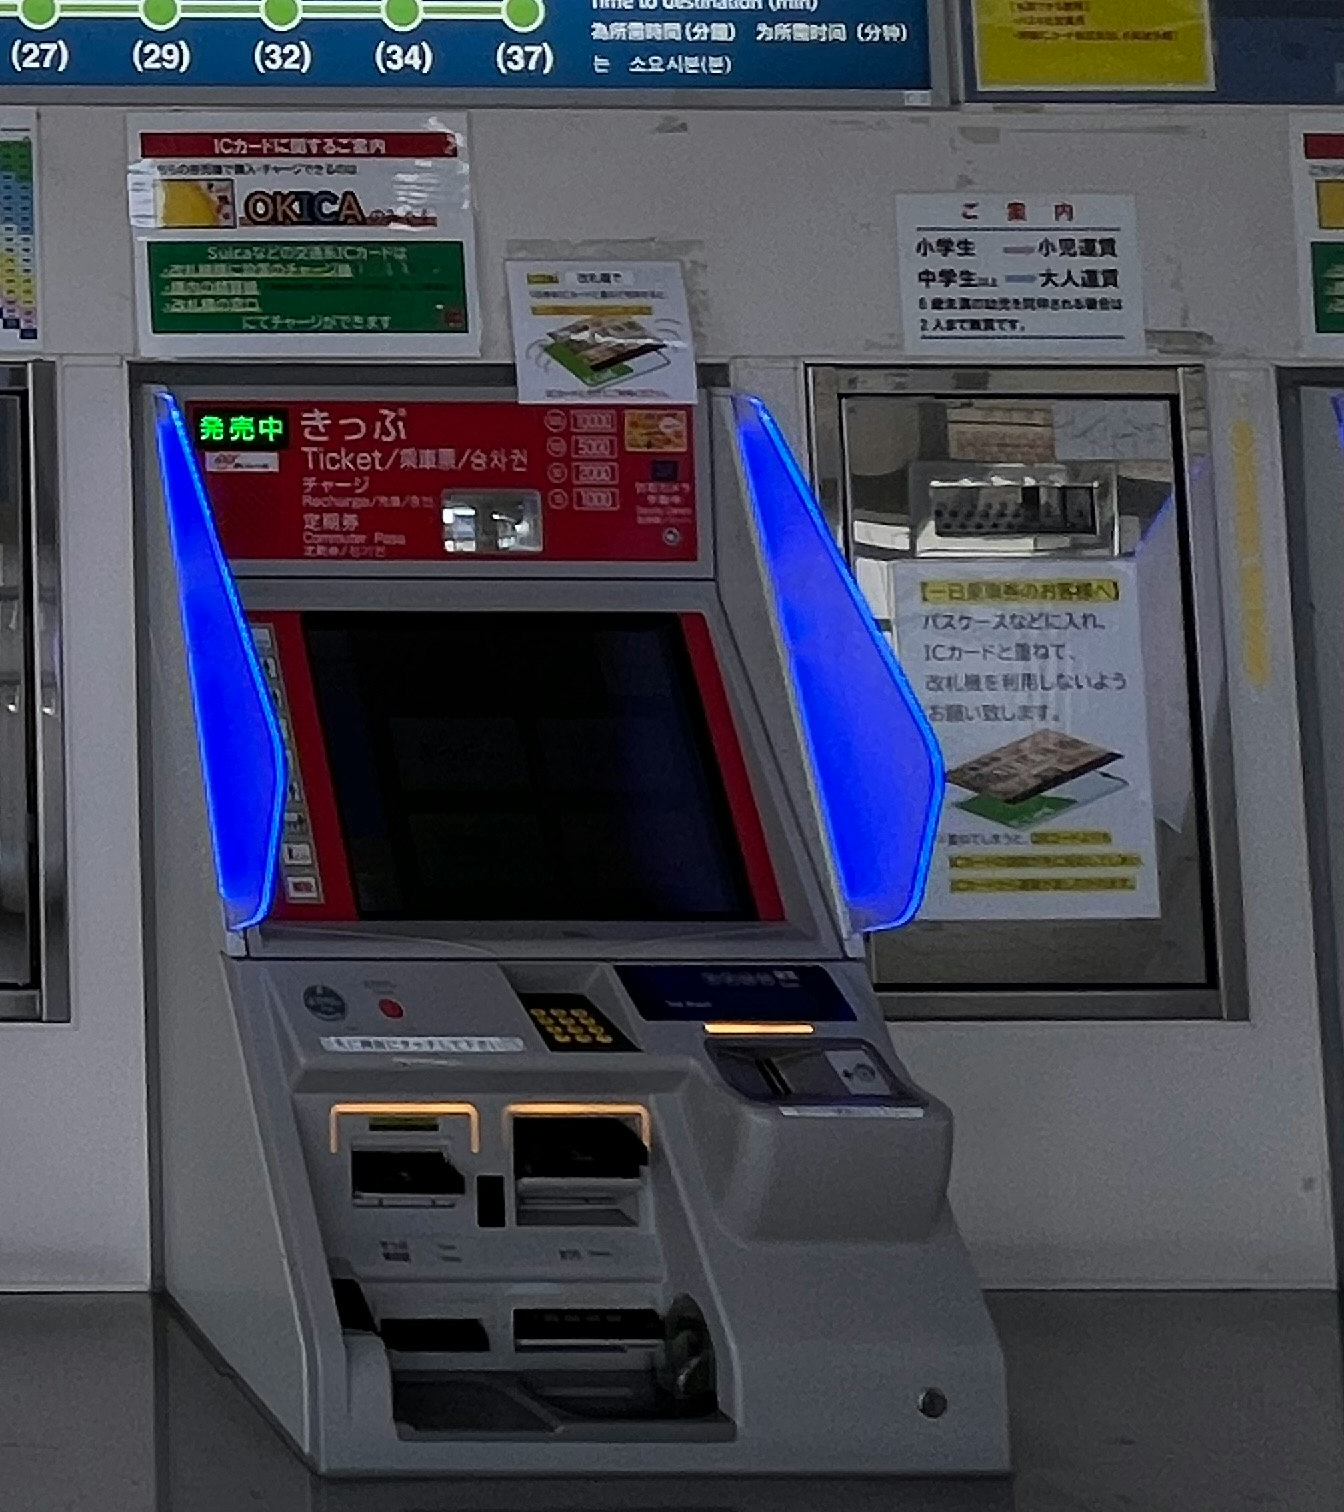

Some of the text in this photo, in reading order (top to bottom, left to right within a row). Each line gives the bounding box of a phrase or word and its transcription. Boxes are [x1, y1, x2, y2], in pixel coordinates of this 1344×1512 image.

[11, 40, 70, 72] (27)
[132, 41, 191, 72] (29)
[253, 41, 312, 73] (32)
[374, 42, 434, 74] (34)
[495, 42, 555, 75] (37)
[244, 190, 365, 224] OKICA
[916, 238, 977, 258] 小学生
[199, 416, 284, 442] 発売中
[300, 408, 408, 442] きっぷ
